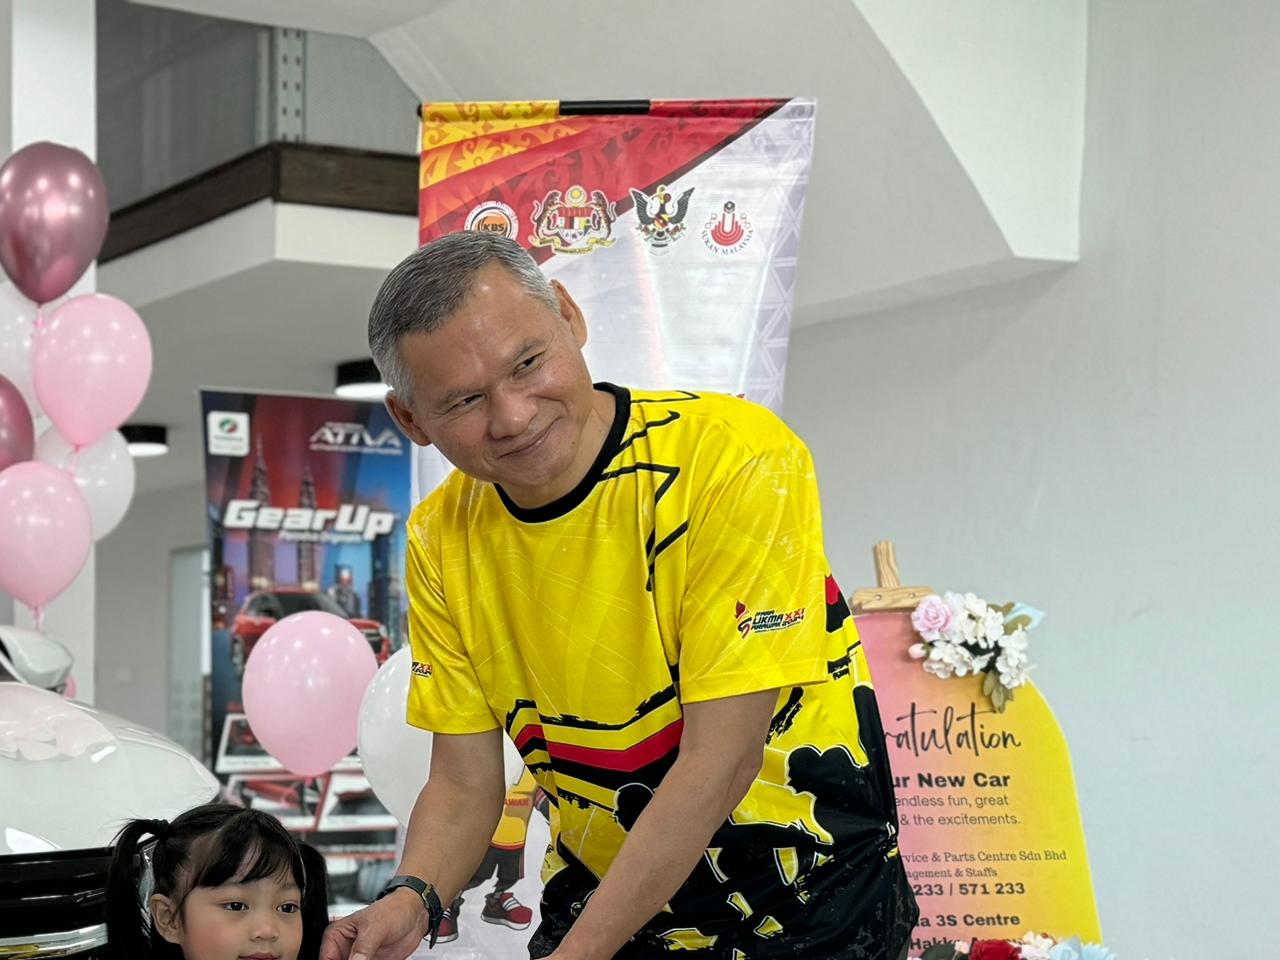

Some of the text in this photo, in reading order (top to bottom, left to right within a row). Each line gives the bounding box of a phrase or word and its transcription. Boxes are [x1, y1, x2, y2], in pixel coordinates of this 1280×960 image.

[483, 223, 505, 232] KBS
[917, 773, 965, 788] New
[973, 773, 1010, 787] Car
[896, 795, 1009, 808] endless fun, great
[900, 813, 1021, 825] & the excitements.
[931, 852, 941, 863] &
[944, 851, 975, 863] Parts
[978, 851, 1017, 862] Centre
[1019, 850, 1042, 861] Sdn
[1044, 850, 1067, 861] Bhd
[954, 868, 964, 878] &
[965, 867, 998, 878] Staffs
[913, 884, 944, 896] 233
[959, 883, 990, 895] 571
[995, 882, 1026, 894] 233
[936, 914, 957, 926] 3S
[963, 914, 1020, 926] Centre
[910, 937, 960, 950] Hakk
